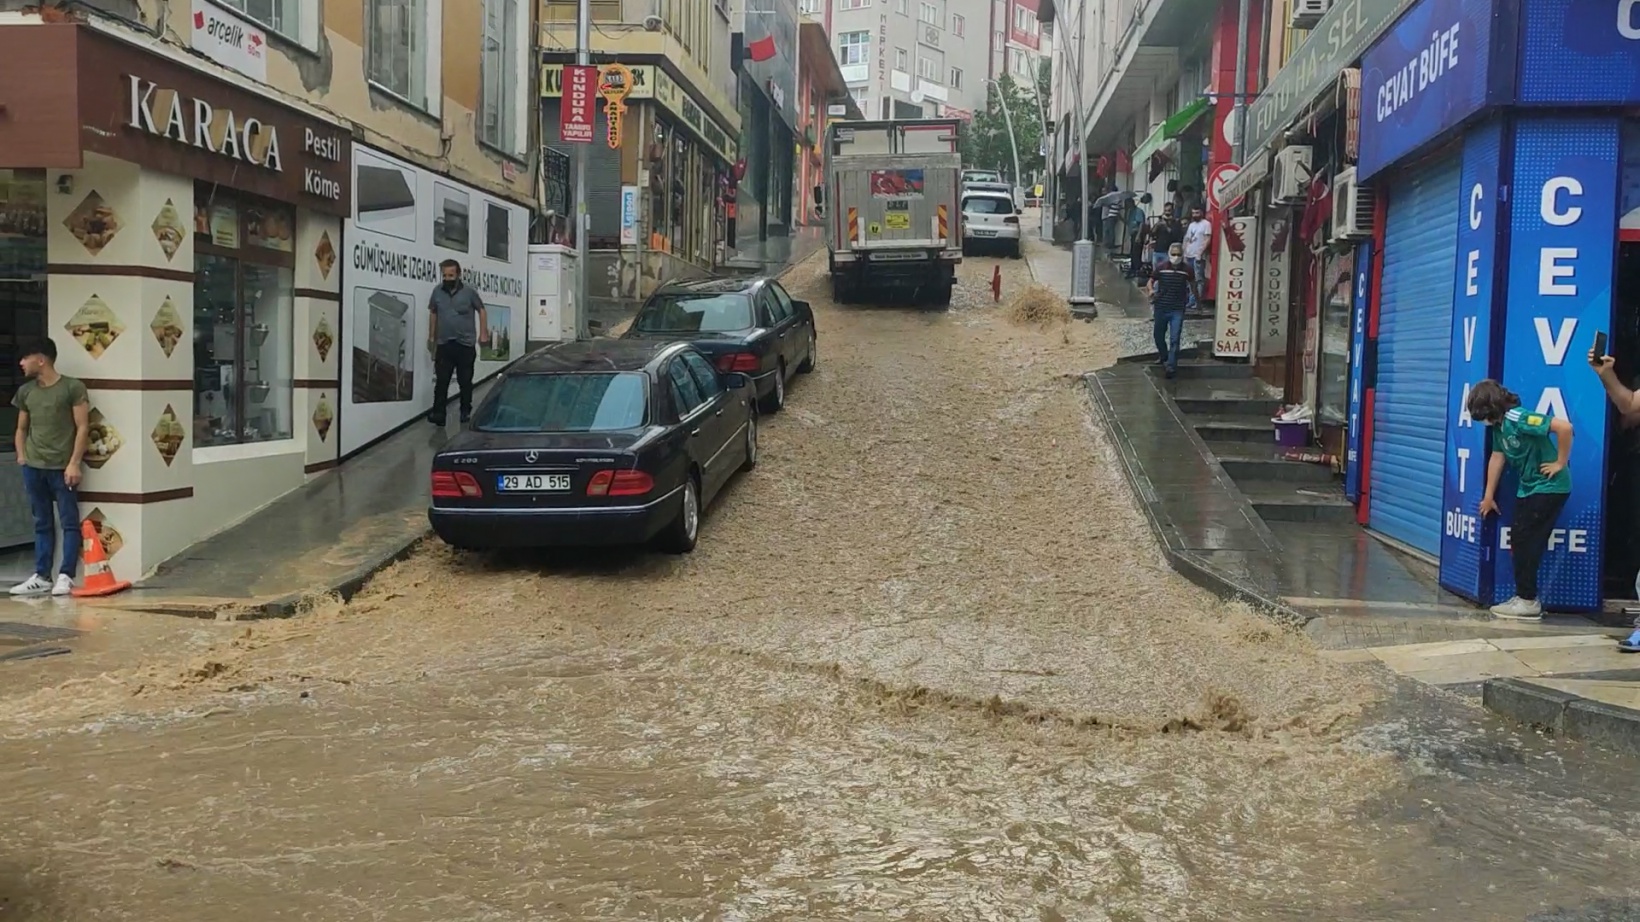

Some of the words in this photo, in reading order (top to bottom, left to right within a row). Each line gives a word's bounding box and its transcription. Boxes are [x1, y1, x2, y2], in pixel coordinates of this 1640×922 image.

[208, 17, 244, 49] arçelik
[571, 68, 586, 122] KUNDURA
[1376, 59, 1418, 123] CEVAT
[1418, 22, 1460, 93] BÜFE
[129, 74, 284, 173] KARACA
[1256, 80, 1290, 139] FOTO
[304, 127, 341, 162] Pestil
[304, 168, 341, 200] Köme
[353, 240, 408, 278] GÜMÜŞHANE
[482, 272, 499, 298] SATIŞ
[1226, 268, 1244, 325] GÜMÜŞ
[1225, 328, 1239, 337] &
[1533, 176, 1583, 437] CEVA
[1216, 340, 1247, 353] SAAT
[1351, 273, 1364, 437] CEVAT
[1457, 183, 1483, 493] CEVAT
[504, 476, 519, 489] 29
[525, 476, 543, 489] AD
[549, 475, 570, 488] 515
[1446, 508, 1476, 543] BÜFE
